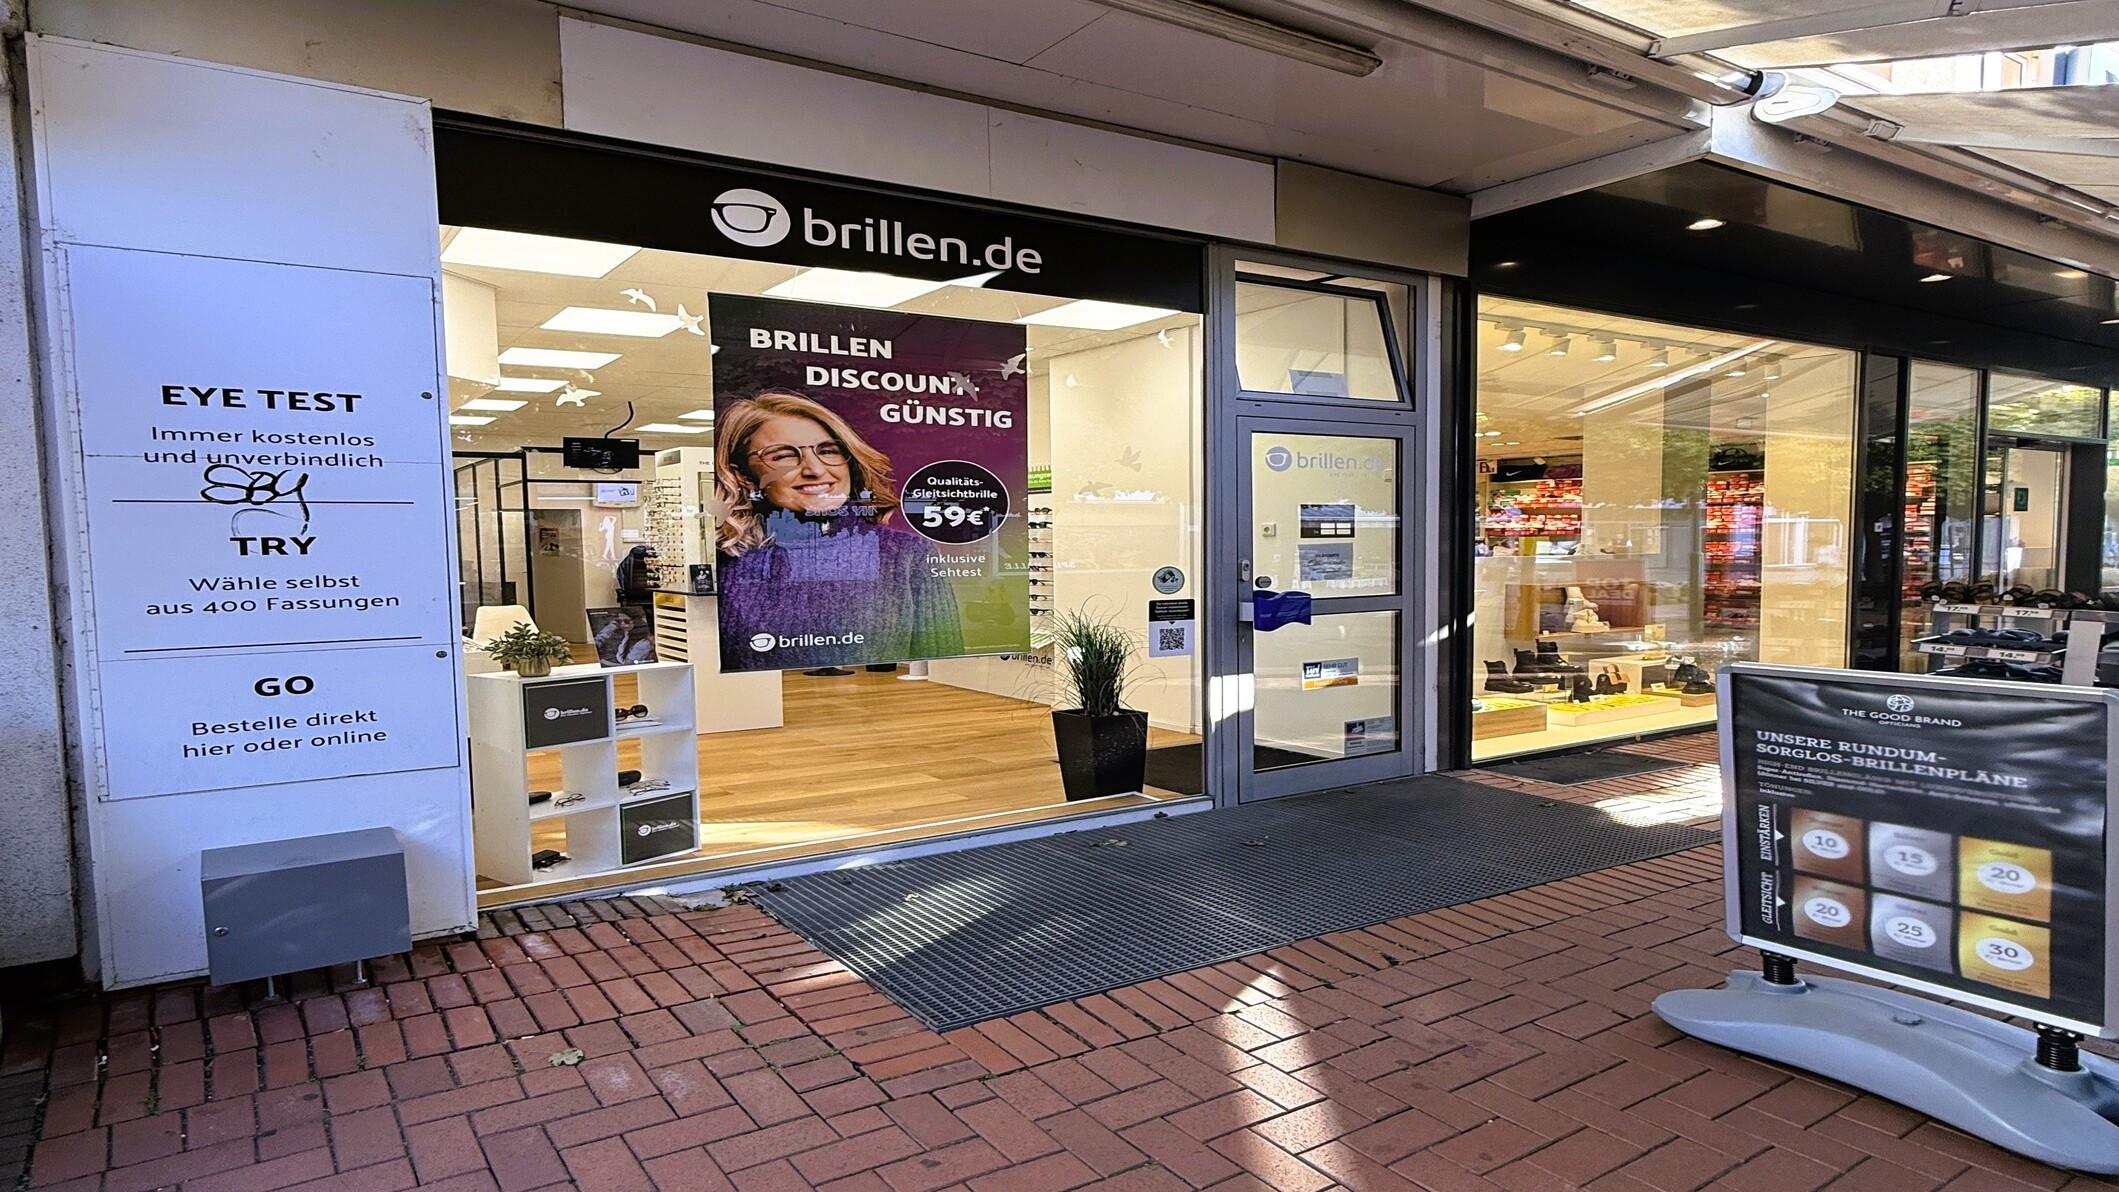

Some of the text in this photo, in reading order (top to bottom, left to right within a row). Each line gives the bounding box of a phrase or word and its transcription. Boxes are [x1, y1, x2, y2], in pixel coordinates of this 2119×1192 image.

[803, 207, 1043, 274] brillen.de
[749, 327, 893, 360] BRILLEN
[161, 385, 362, 413] EYE TEST
[880, 400, 1013, 428] GÜNSTIG
[151, 426, 375, 447] Immer kostenlos
[143, 449, 384, 468] und unverbindlich
[927, 476, 984, 487] Qualitäts-
[913, 488, 998, 499] Gleitsichtbrille
[229, 536, 317, 556] TRY
[926, 553, 986, 565] inklusive
[930, 567, 983, 578] Sehtest
[189, 574, 361, 592] Wähle selbst
[146, 594, 400, 615] aus 400 Fassungen
[779, 632, 865, 649] brillen.de
[253, 675, 315, 698] GO
[192, 709, 378, 736] Bestelle direkt
[1841, 708, 1962, 727] THE GOOD BRAND
[182, 729, 388, 759] hier oder online
[1756, 730, 1948, 763] UNSERE RUNDUM-
[1756, 743, 2029, 789] SORGLOS-BRILLENPLÄNE
[1756, 804, 1773, 861] EINSTÄRKEN
[1815, 835, 1838, 849] 10
[1897, 851, 1924, 865] 15
[1991, 866, 2020, 882] 20
[1760, 871, 1774, 925] GLEITSICHT
[1815, 902, 1840, 917] 20
[1897, 922, 1923, 937] 25
[1988, 943, 2019, 959] 30
